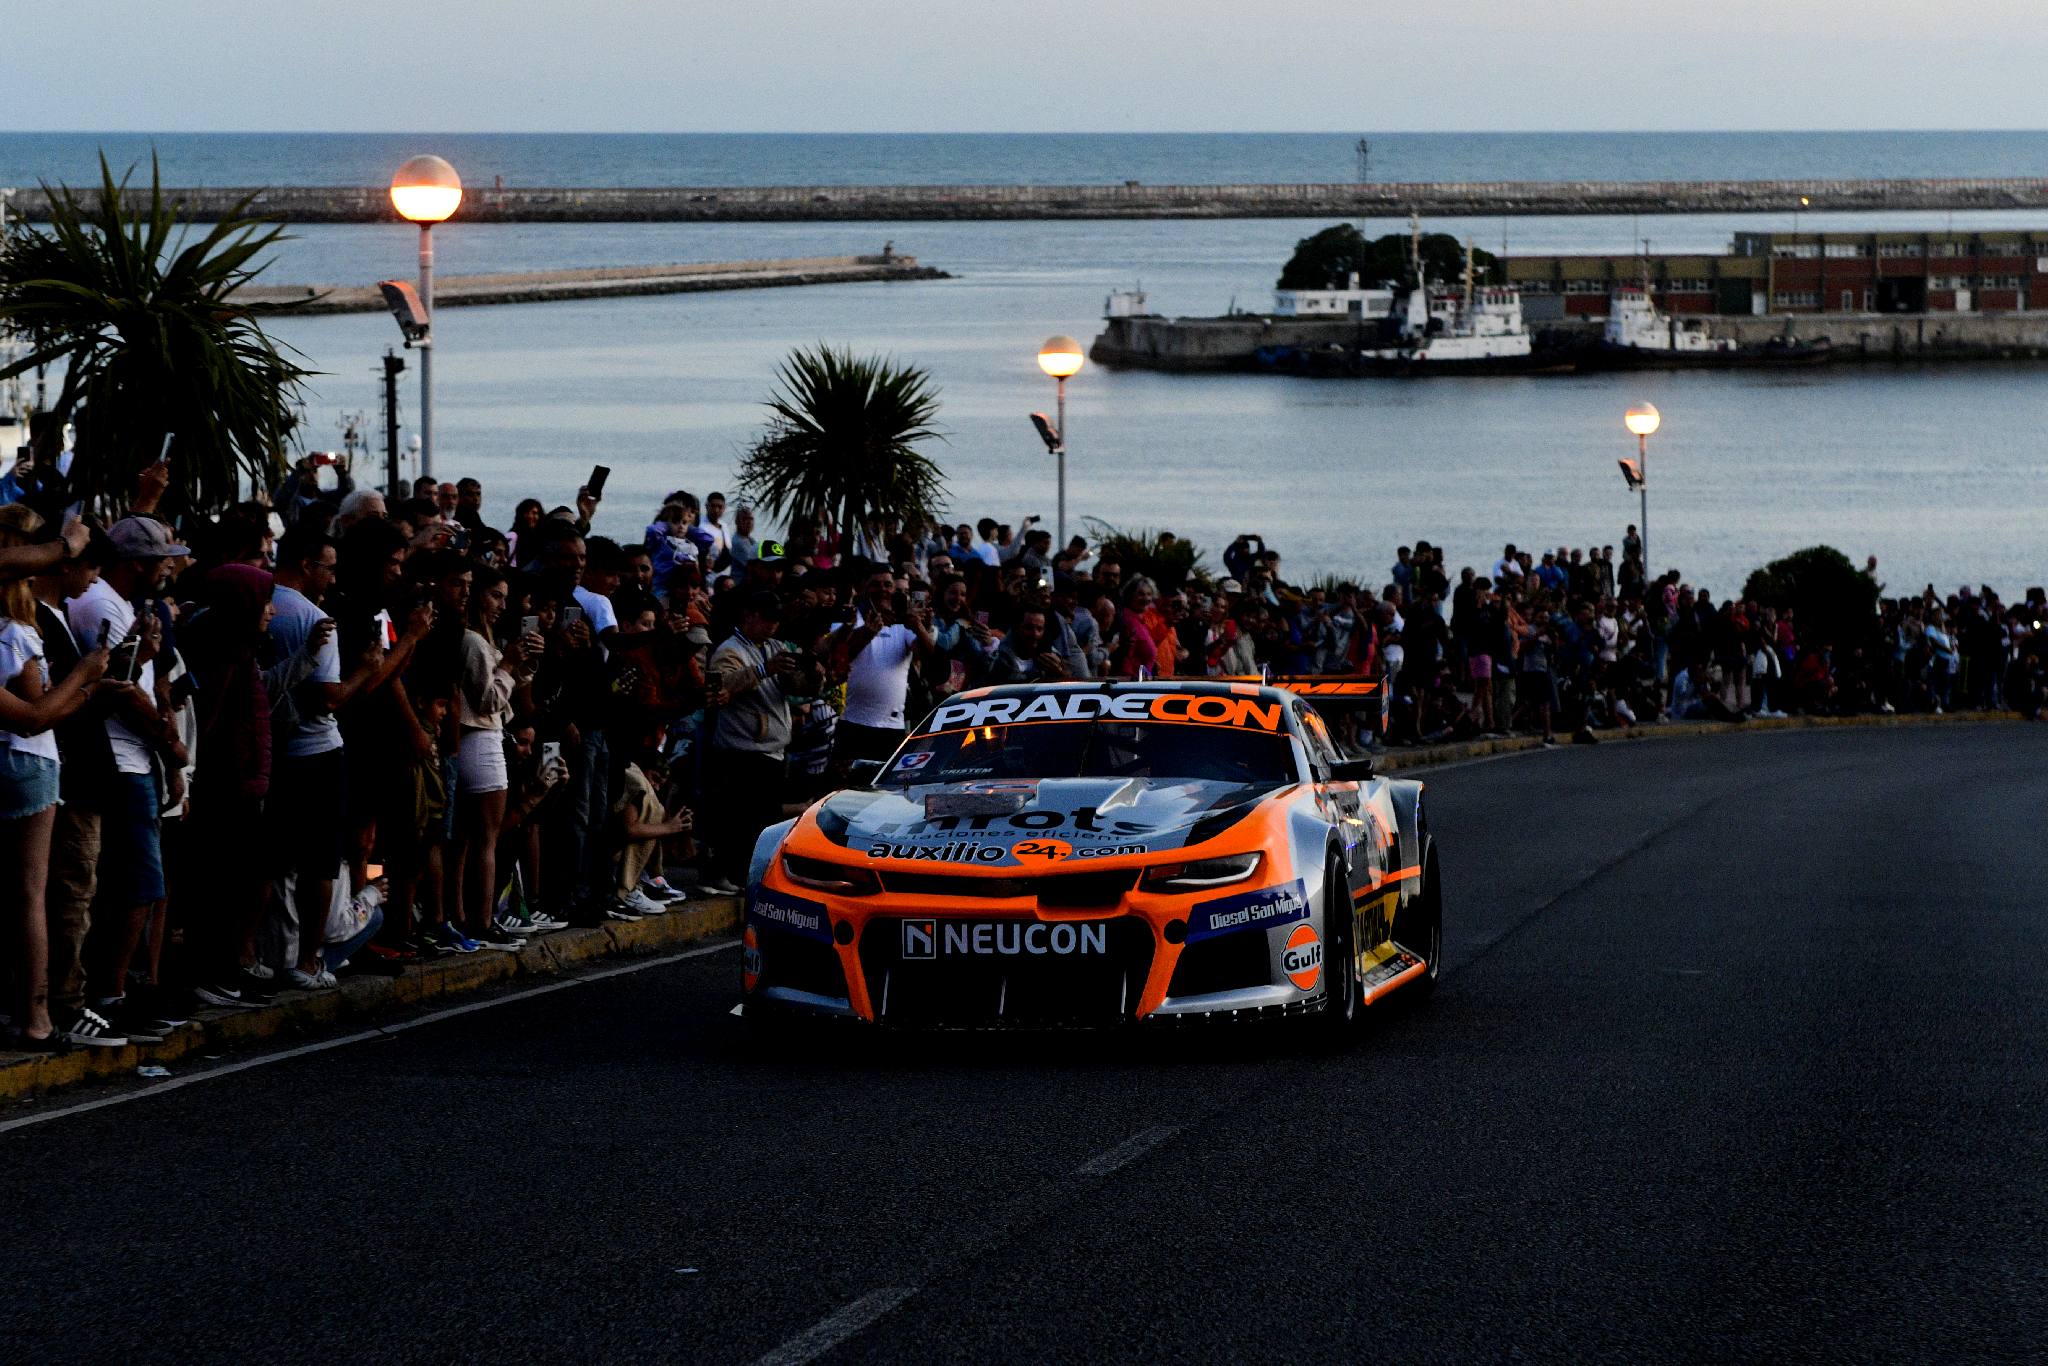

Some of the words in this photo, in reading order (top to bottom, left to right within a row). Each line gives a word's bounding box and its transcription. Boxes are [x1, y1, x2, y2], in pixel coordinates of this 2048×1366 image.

[929, 693, 1282, 733] PRADECON
[869, 842, 1004, 861] auxilio
[768, 904, 785, 922] San
[1209, 906, 1250, 930] Diesel
[1251, 903, 1275, 919] San
[945, 923, 1105, 954] NEUCON
[1284, 945, 1321, 971] Gulf
